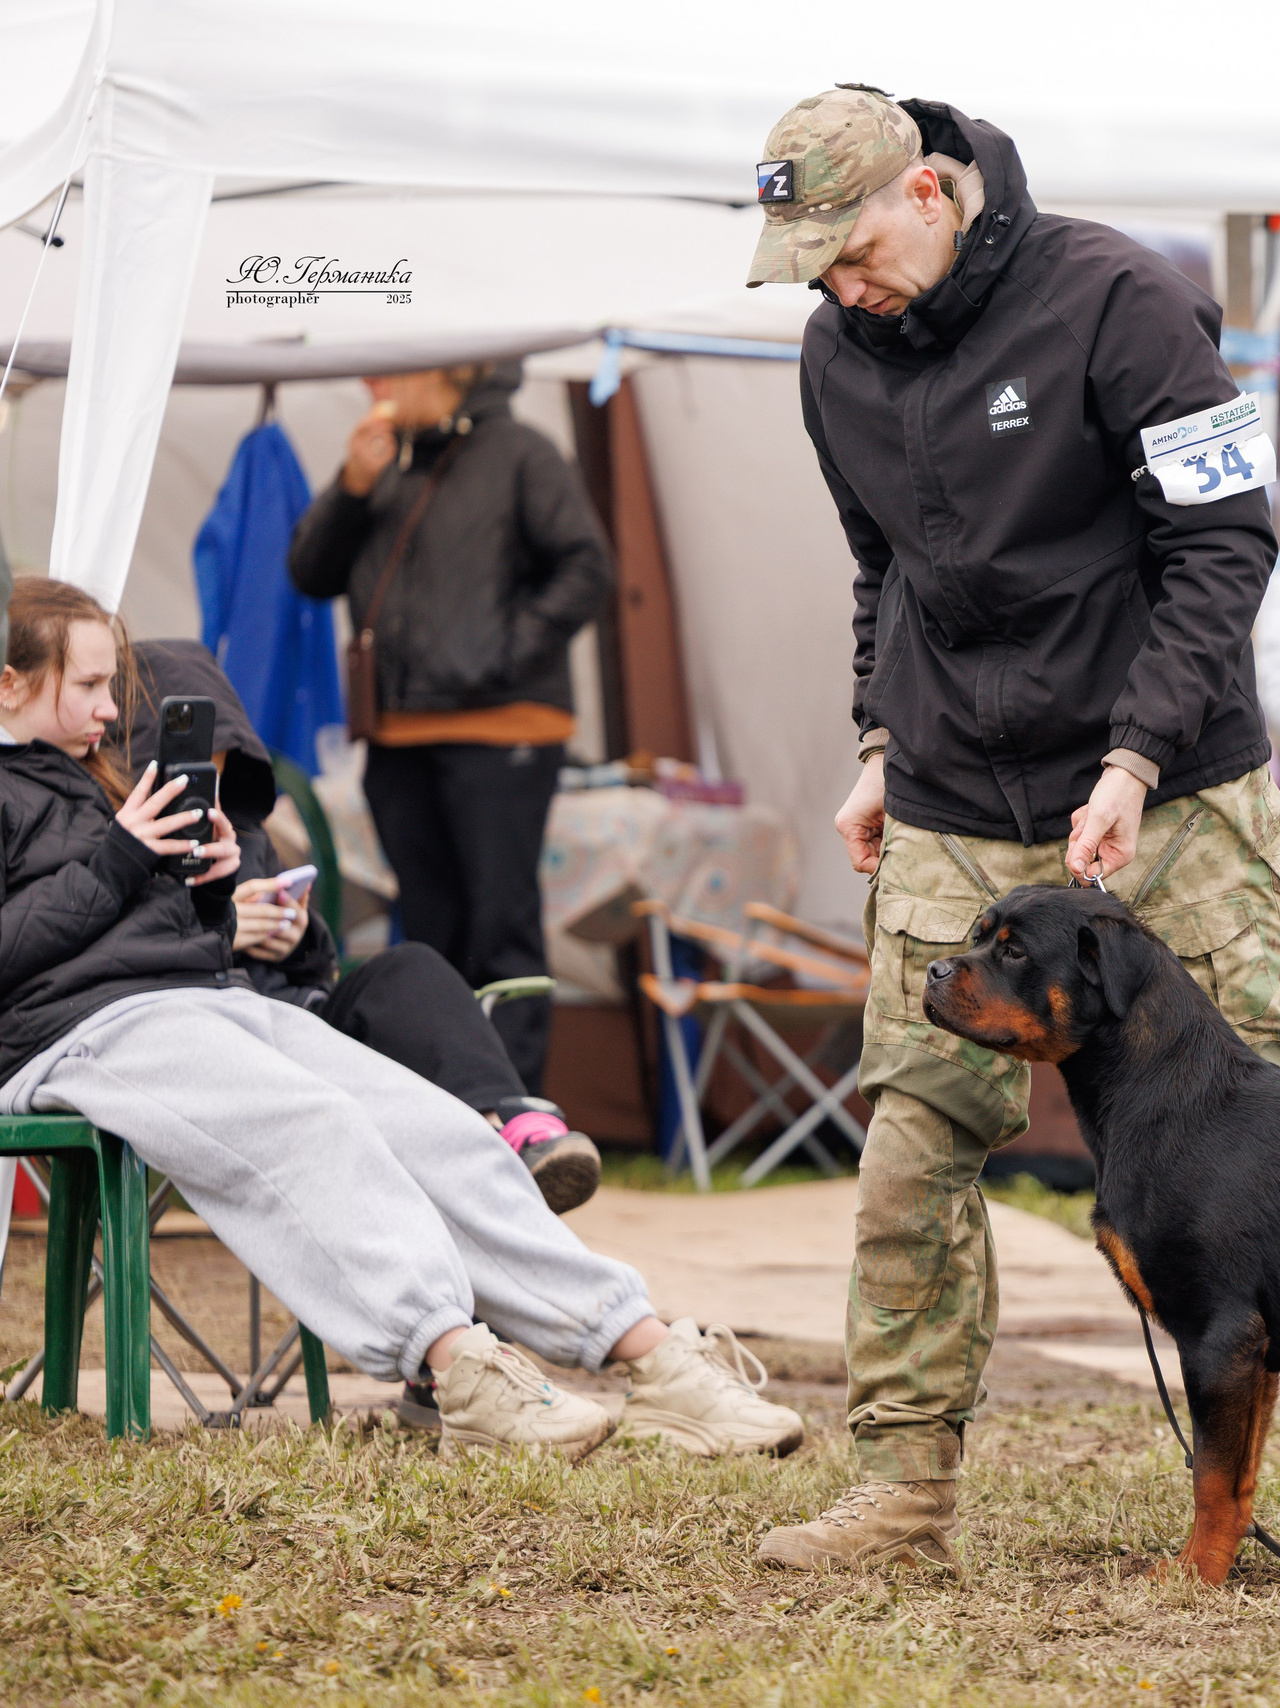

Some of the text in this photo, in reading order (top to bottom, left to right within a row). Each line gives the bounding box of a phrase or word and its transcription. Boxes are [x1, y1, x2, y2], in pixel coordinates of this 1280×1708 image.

[773, 175, 788, 197] Z
[989, 400, 1027, 415] adidas
[1218, 400, 1256, 421] STATERA
[991, 416, 1030, 432] TERREX
[1180, 441, 1255, 494] 34
